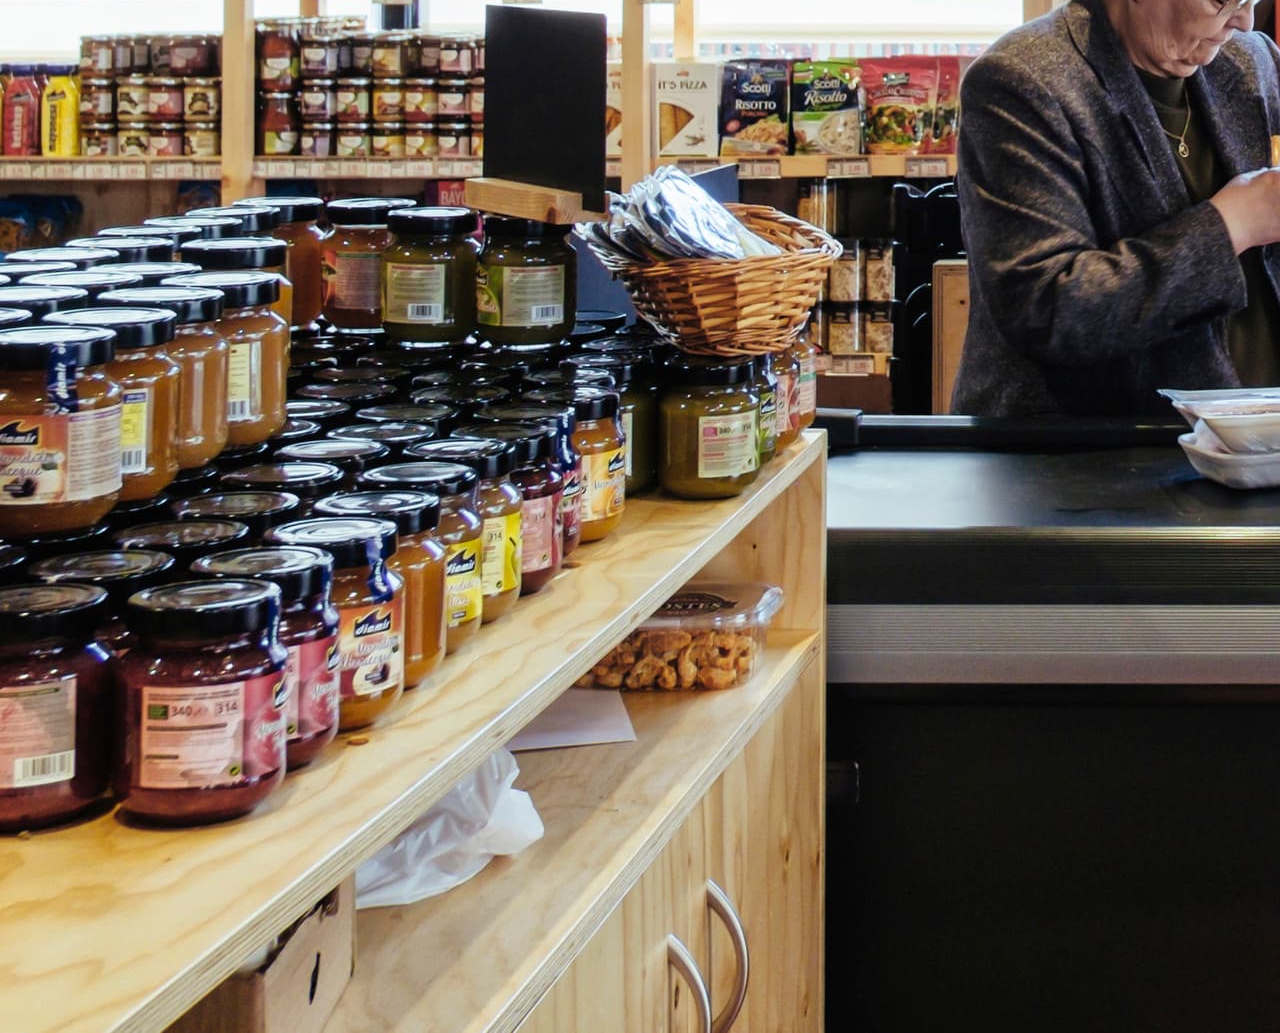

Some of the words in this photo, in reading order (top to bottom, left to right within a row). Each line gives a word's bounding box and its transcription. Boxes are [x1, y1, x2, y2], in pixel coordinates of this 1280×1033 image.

[658, 80, 676, 89] IT'S
[680, 80, 708, 90] PIZZA
[804, 91, 847, 106] Risotto
